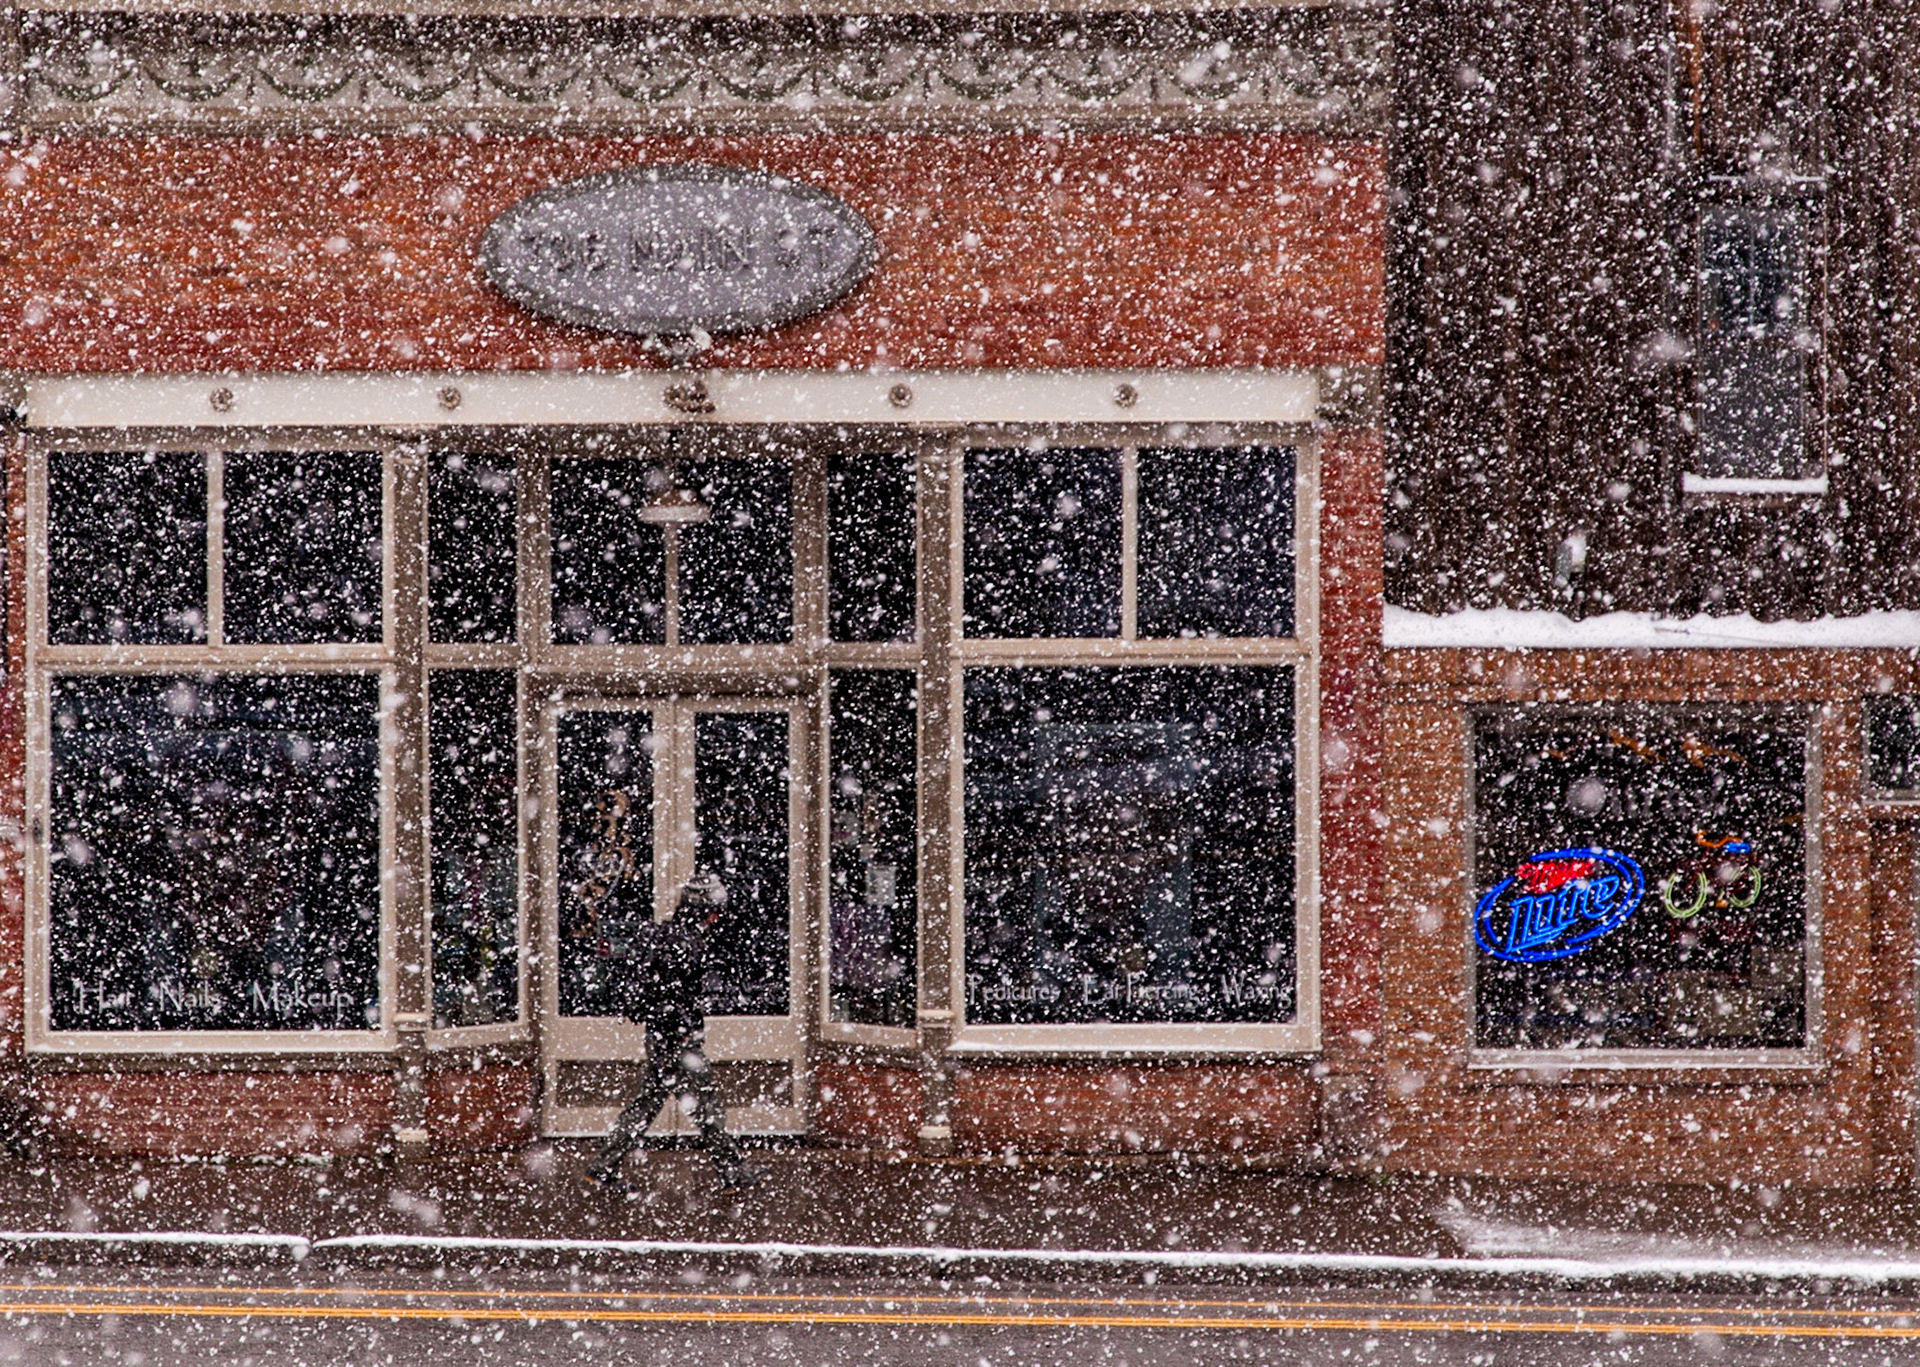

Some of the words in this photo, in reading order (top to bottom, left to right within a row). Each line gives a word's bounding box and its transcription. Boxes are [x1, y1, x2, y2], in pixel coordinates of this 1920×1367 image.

[629, 227, 751, 273] MAIN
[775, 228, 838, 271] ST
[159, 978, 223, 1014] Nails
[252, 979, 355, 1020] Makeup
[966, 973, 1061, 1005] Pedicures
[1220, 970, 1293, 1009] Waxing
